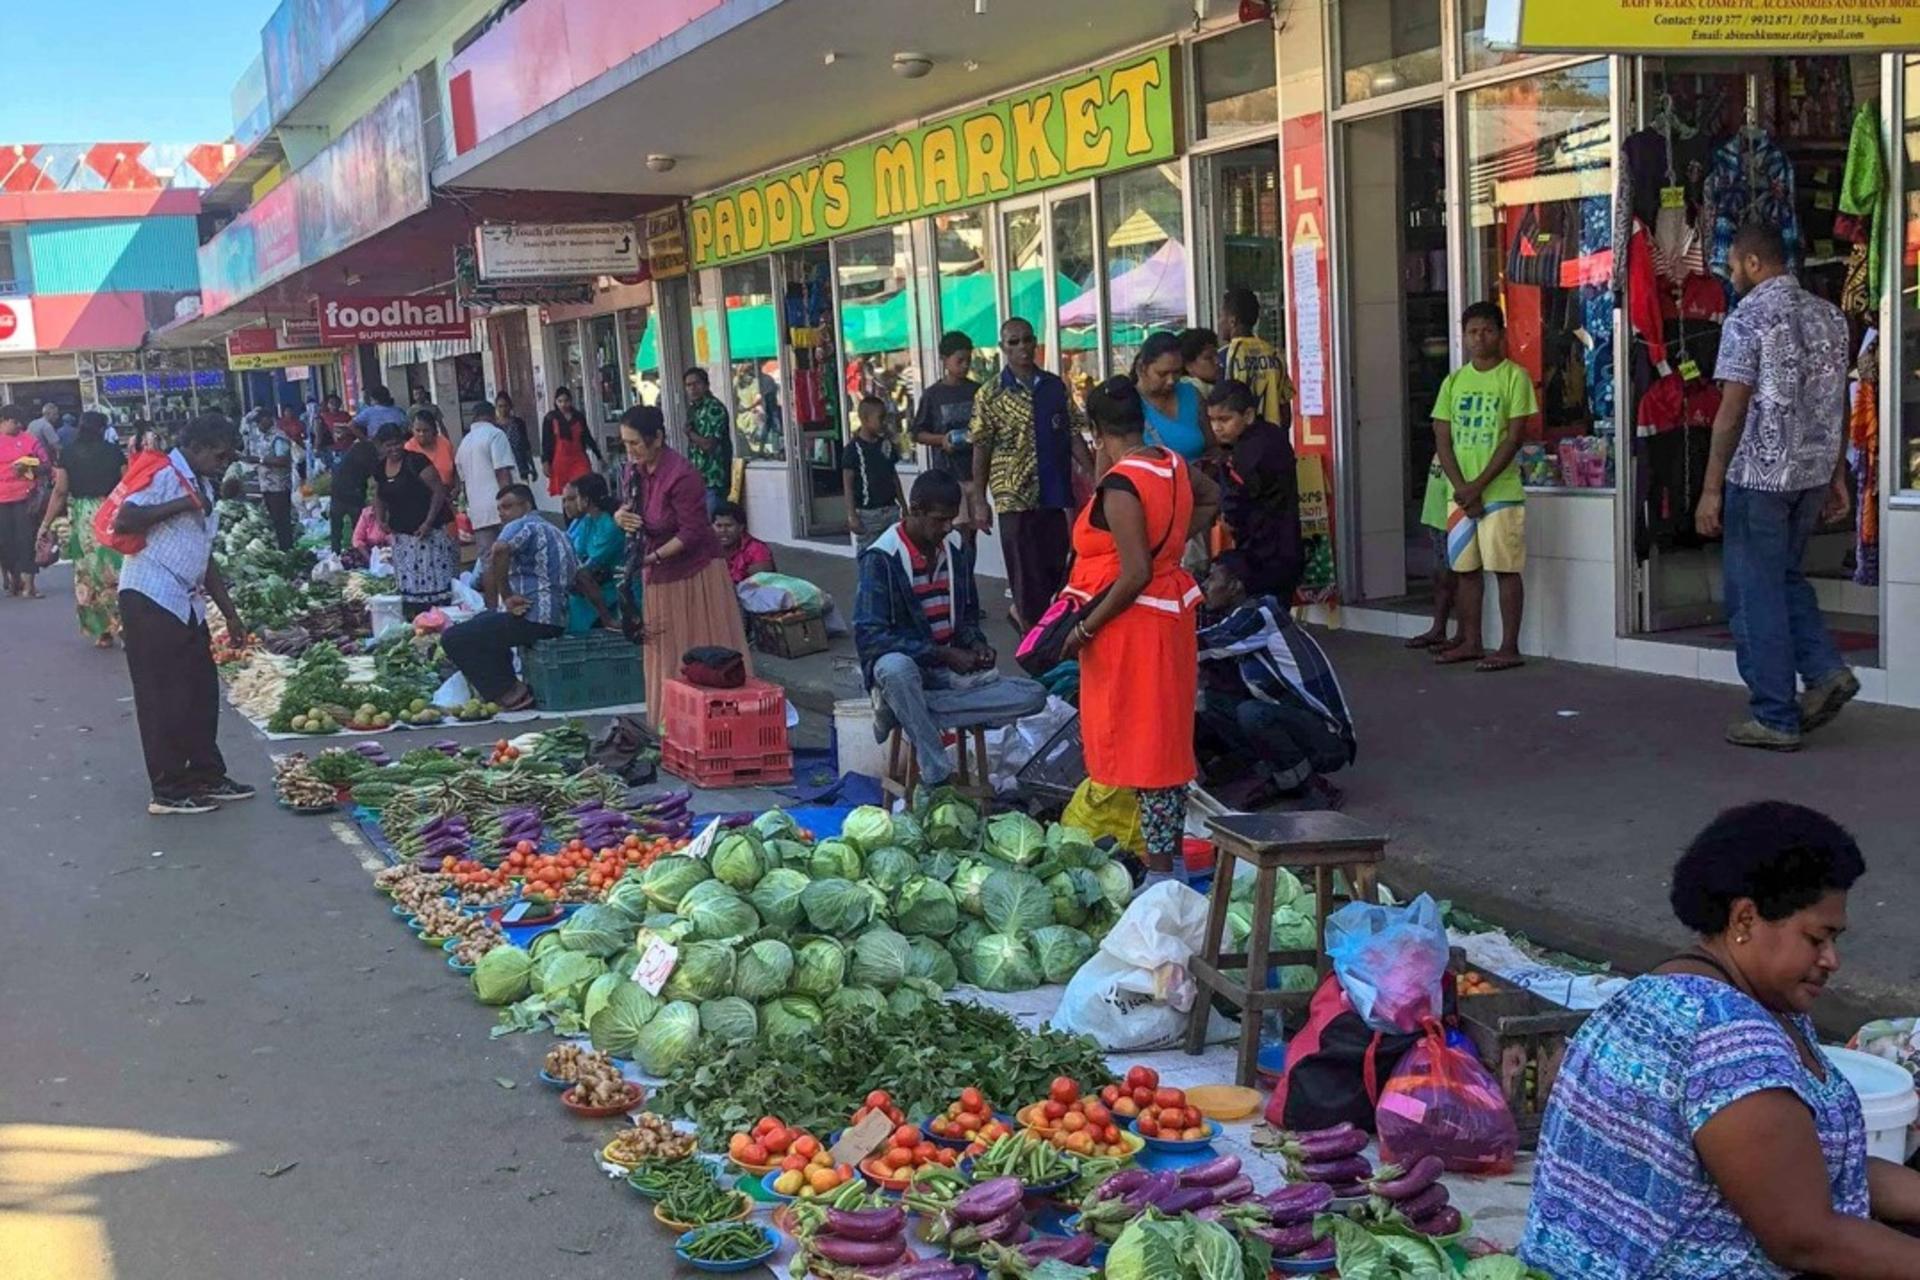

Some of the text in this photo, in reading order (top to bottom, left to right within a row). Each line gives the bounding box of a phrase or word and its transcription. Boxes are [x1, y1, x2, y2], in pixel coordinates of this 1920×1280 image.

[1763, 0, 1834, 8] ACCESSORIES
[1835, 0, 1858, 8] AND
[1859, 0, 1886, 8] MANY
[1654, 14, 1696, 25] Contact:
[1820, 15, 1838, 24] Box
[1866, 14, 1902, 28] Sigatoka
[1691, 29, 1723, 40] Email:
[691, 56, 1162, 264] PADDYS MARKET
[326, 301, 466, 328] foodhall
[358, 329, 437, 341] SUPERMARKET
